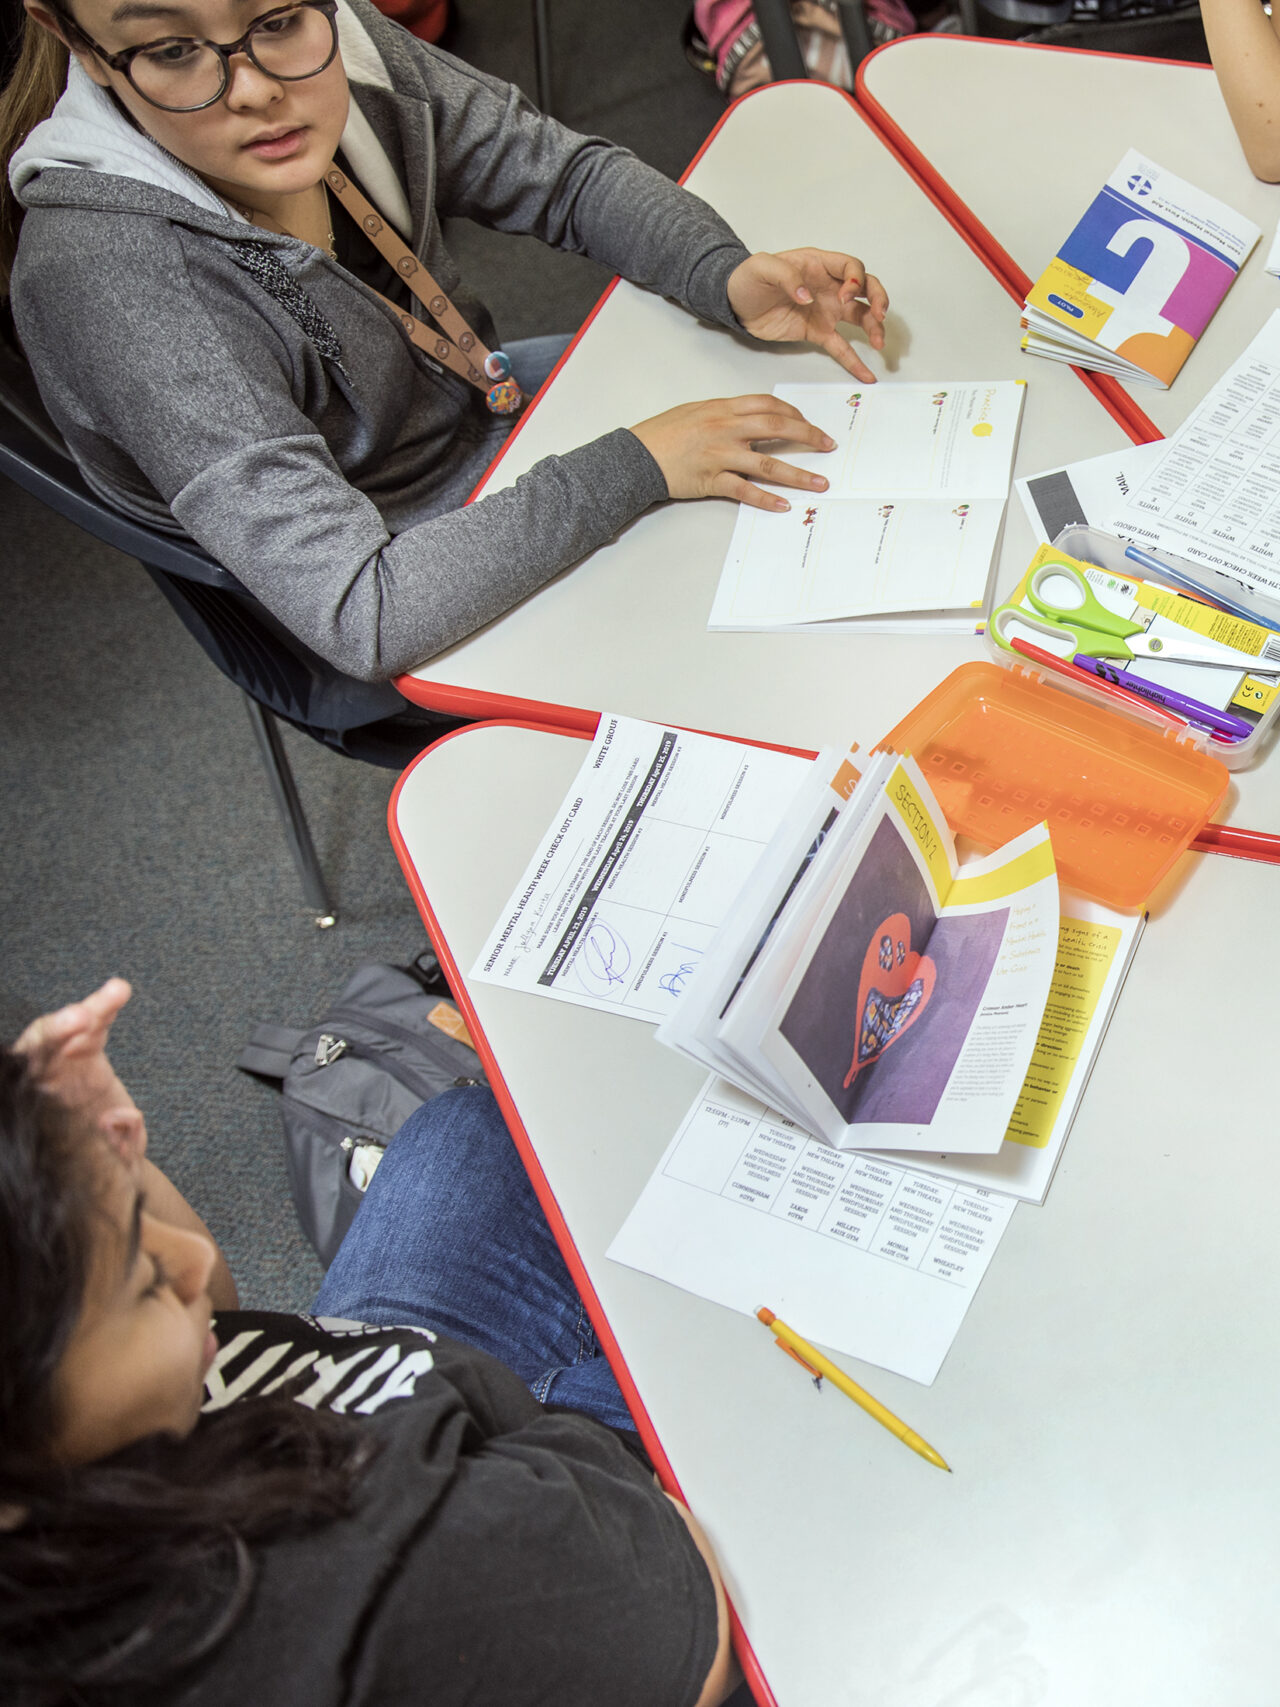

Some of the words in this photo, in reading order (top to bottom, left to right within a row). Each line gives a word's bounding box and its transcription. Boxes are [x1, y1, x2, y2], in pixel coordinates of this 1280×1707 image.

[1057, 299, 1074, 312] PILOT
[1137, 499, 1161, 512] WHITE
[1173, 513, 1198, 526] WHITE
[1136, 527, 1161, 541] WHITE
[1211, 528, 1236, 541] WHITE
[1186, 546, 1208, 558] CARD
[1205, 554, 1223, 564] OUT
[1248, 544, 1274, 557] WHITE
[1221, 560, 1248, 574] CHECK
[1246, 571, 1269, 583] WEEK
[1126, 680, 1167, 704] highlighter
[635, 776, 656, 807] THURSDAY
[650, 762, 664, 777] April
[660, 739, 674, 754] 2019
[650, 788, 663, 807] MENTAL
[658, 771, 672, 789] HEALTH
[667, 752, 681, 771] SESSION
[733, 770, 747, 790] SESSION
[895, 784, 935, 847] SECTION
[483, 942, 504, 972] SENIOR
[499, 909, 522, 942] MENTAL
[516, 880, 539, 910] HEALTH
[533, 858, 551, 880] WEEK
[545, 833, 565, 858] CHECK
[559, 818, 572, 833] OUT
[567, 796, 584, 817] CARD
[591, 745, 610, 769] WHITE
[535, 933, 547, 948] MAKE
[543, 921, 554, 934] SURE
[550, 911, 559, 921] YOU
[555, 891, 570, 911] RECEIVE
[568, 872, 580, 888] STAMP
[580, 857, 588, 866] THE
[585, 845, 595, 857] END
[594, 827, 605, 840] EACH
[619, 780, 629, 792] LOSE
[624, 769, 634, 780] THIS
[551, 917, 563, 933] LEAVE
[560, 906, 569, 917] THIS
[565, 892, 576, 906] CARD
[572, 879, 583, 893] CARD
[579, 867, 590, 880] WITH
[586, 855, 597, 868] YOUR
[593, 843, 603, 855] LAST
[600, 823, 614, 843] TEACHER
[613, 804, 623, 816] YOUR
[620, 792, 629, 804] LAST
[590, 855, 615, 892] WEDNESDAY
[610, 841, 624, 856] April
[622, 819, 635, 833] 2019
[607, 870, 620, 889] MENTAL
[616, 851, 631, 871] HEALTH
[626, 833, 640, 852] SESSION
[677, 869, 698, 903] MINDFULNESS
[694, 851, 707, 870] SESSION
[546, 947, 566, 976] TUESDAY
[561, 929, 576, 948] APRIL
[576, 905, 589, 920] 2019
[561, 956, 576, 976] MENTAL
[571, 937, 586, 957] HEALTH
[581, 916, 596, 937] SESSION
[1062, 935, 1086, 946] health
[503, 957, 517, 976] NAME
[633, 956, 655, 991] MINDFULNESS
[650, 936, 665, 957] SESSION
[1040, 1043, 1062, 1051] direction
[1029, 1084, 1051, 1092] behavior
[806, 1151, 820, 1159] NEW
[819, 1156, 845, 1168] THEATER
[816, 1147, 841, 1159] TUESDAY
[792, 1170, 805, 1178] AND
[805, 1175, 835, 1189] THURSDAY
[801, 1165, 835, 1181] WEDNESDAY
[790, 1178, 830, 1196] MINDFULNESS
[794, 1187, 818, 1200] SESSION
